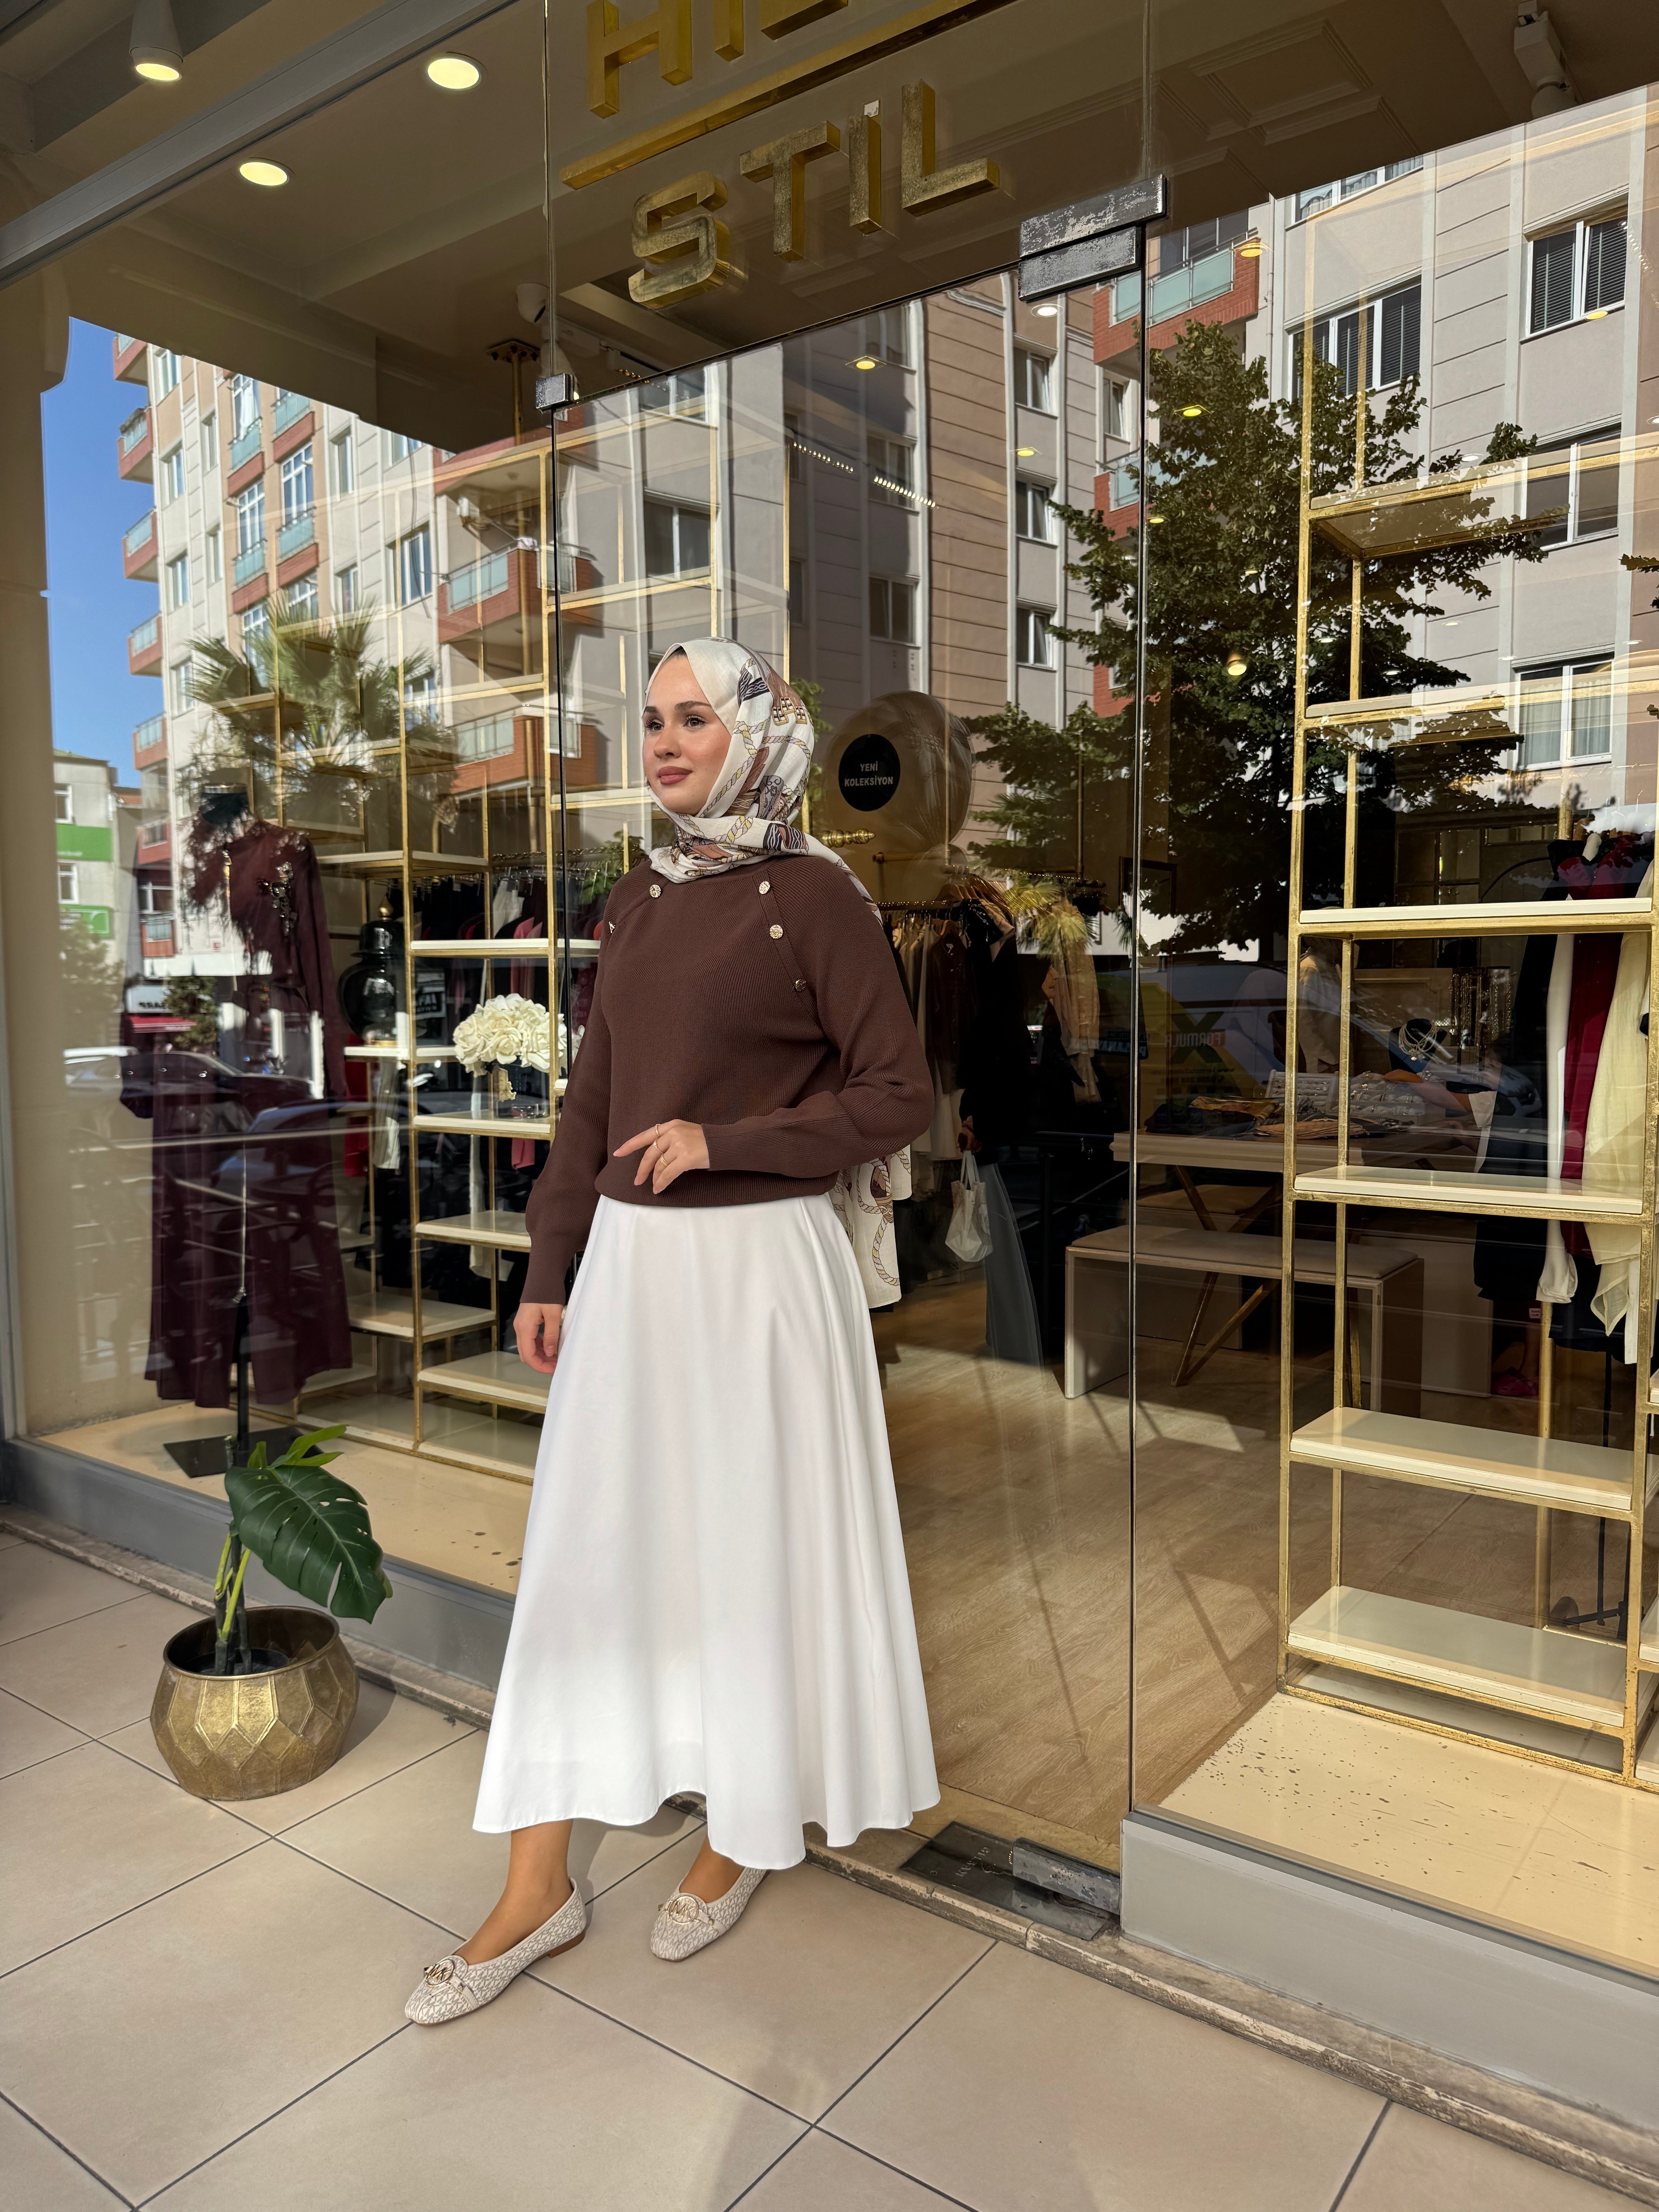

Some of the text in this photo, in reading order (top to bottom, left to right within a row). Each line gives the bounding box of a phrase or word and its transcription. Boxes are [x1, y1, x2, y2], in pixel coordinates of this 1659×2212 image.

[628, 80, 1000, 309] STIL
[860, 761, 878, 772] YENİ
[844, 775, 893, 787] KOLEKSİYON
